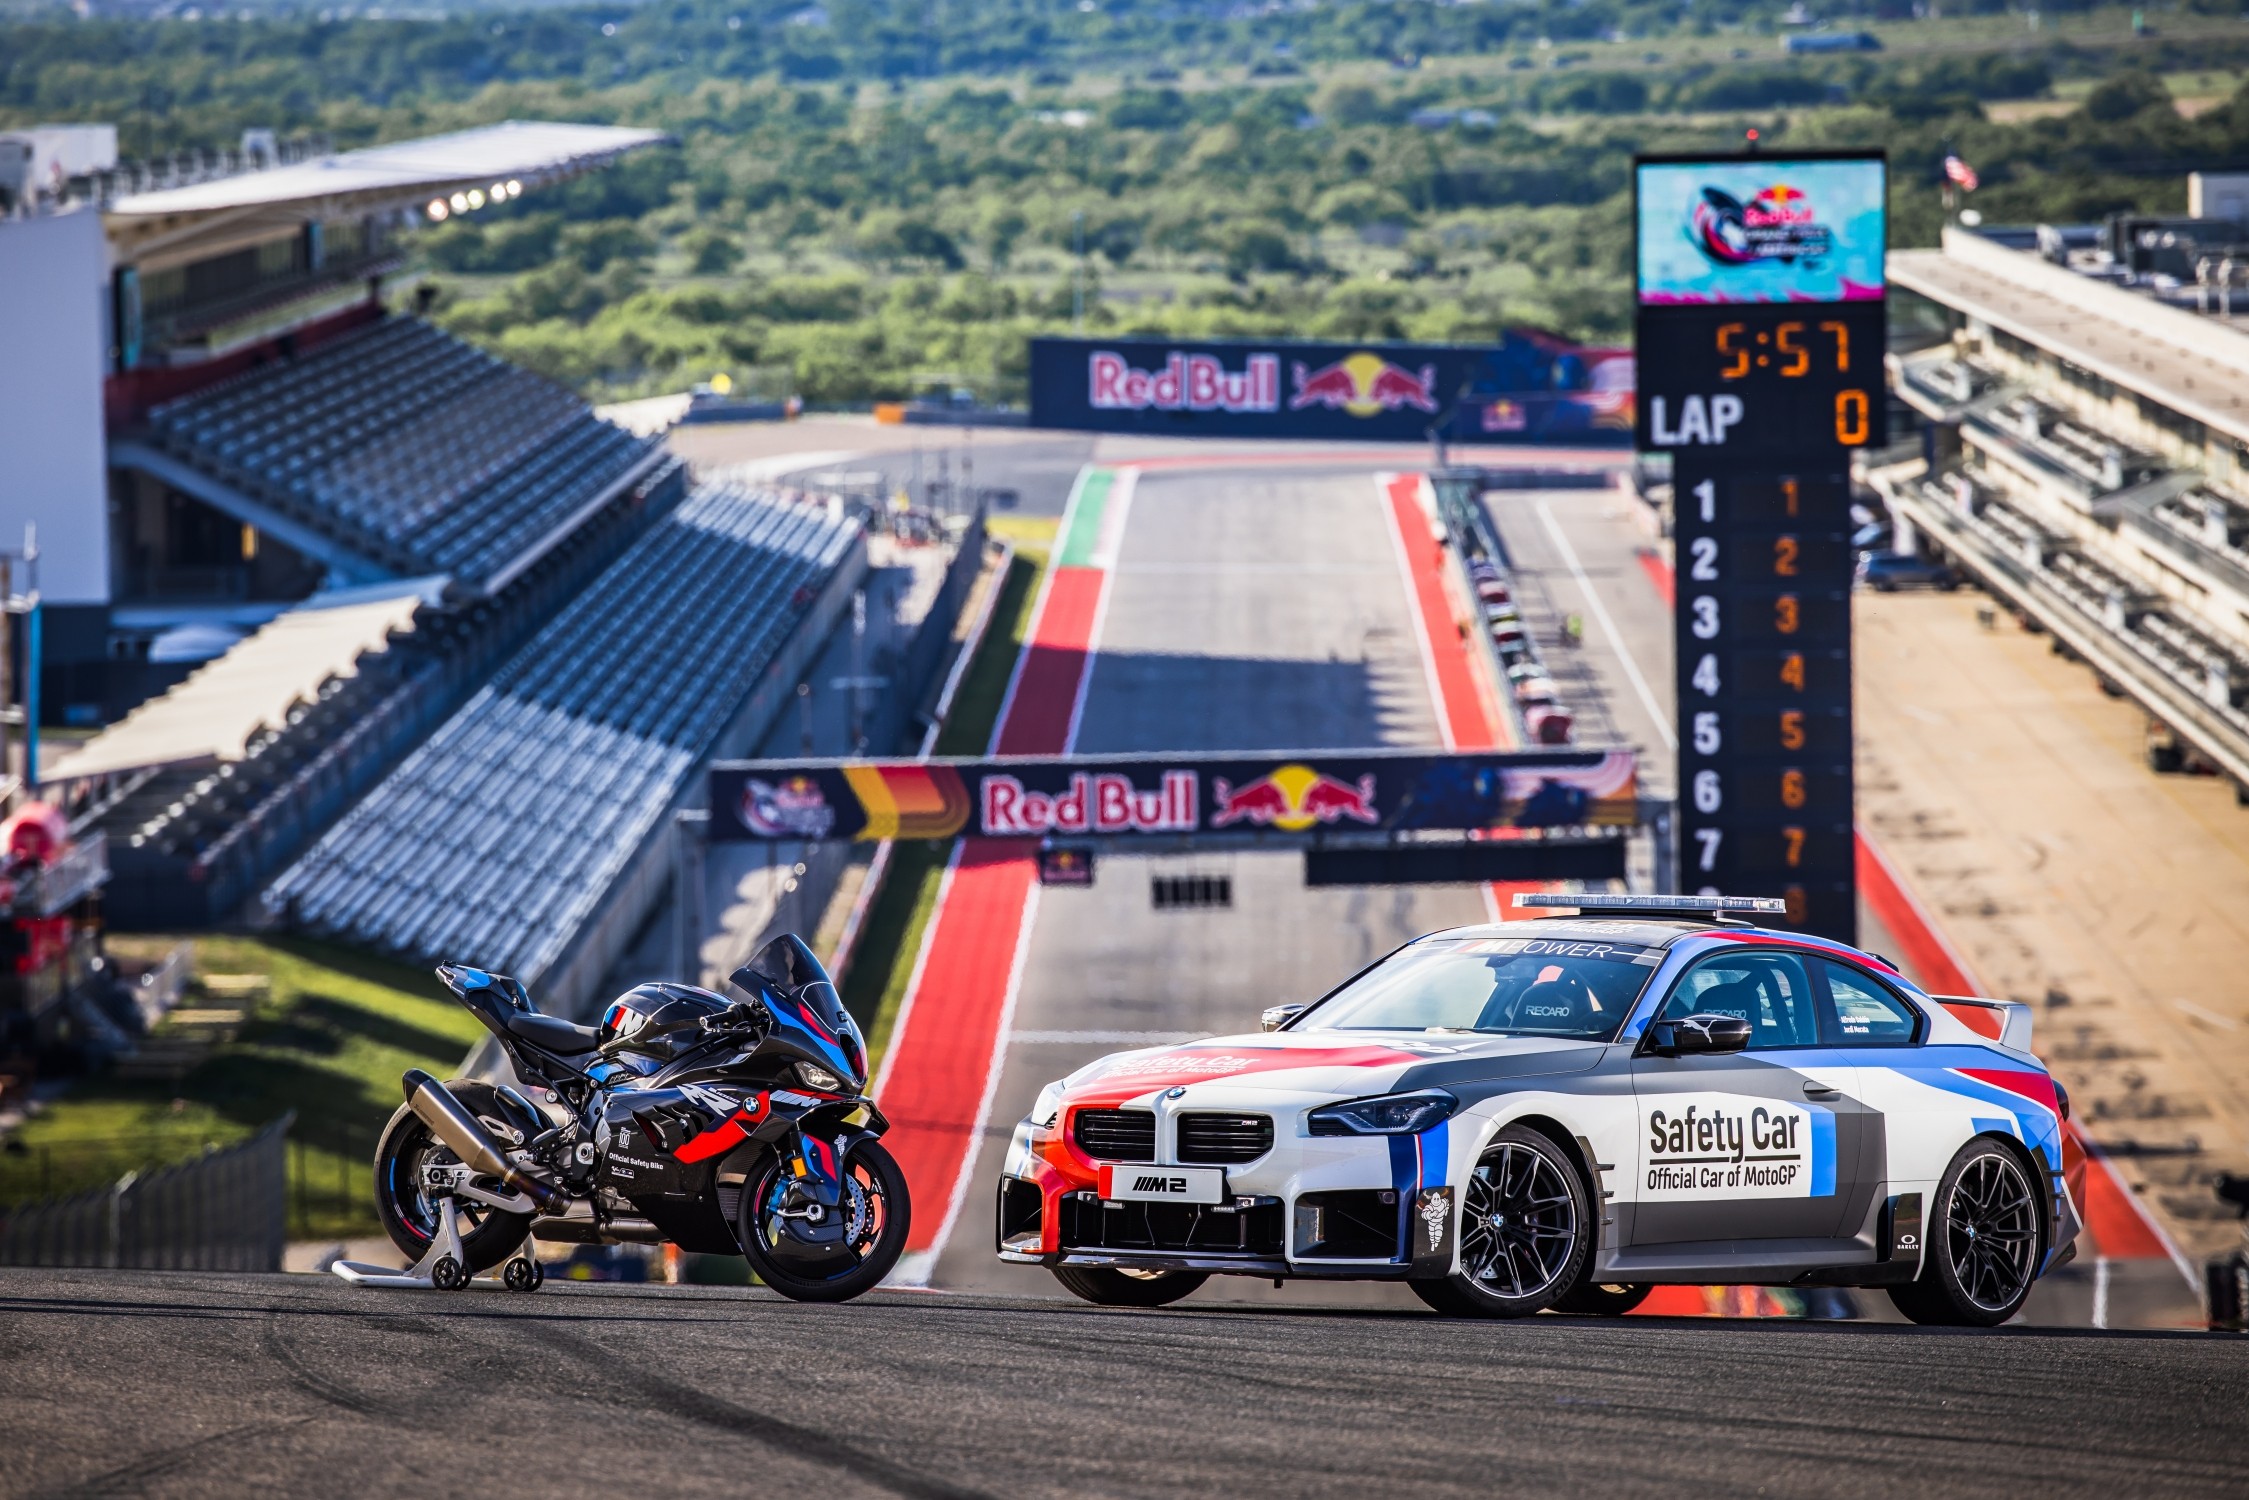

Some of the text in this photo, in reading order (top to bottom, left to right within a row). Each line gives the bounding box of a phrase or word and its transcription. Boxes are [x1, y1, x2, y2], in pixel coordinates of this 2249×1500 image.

[1716, 321, 1849, 378] 5:57
[1090, 352, 1279, 412] Red Bull
[1651, 388, 1869, 445] LAP 0
[1692, 478, 1798, 523] 1 1
[1690, 535, 1798, 581] 2 2
[1692, 594, 1799, 639] 3 3
[1692, 652, 1804, 697] 4 4
[1693, 711, 1805, 755] 5 5
[981, 770, 1198, 836] Red Bull
[1693, 769, 1806, 814] 6 6
[1694, 827, 1806, 871] 7 7
[1525, 1005, 1570, 1018] RECARO
[1206, 1056, 1262, 1067] Car
[1650, 1105, 1800, 1163] Safety Car
[609, 1153, 664, 1170] Official Safety Bike
[1647, 1166, 1697, 1190] Official
[1700, 1167, 1724, 1188] Car
[1727, 1165, 1742, 1187] of
